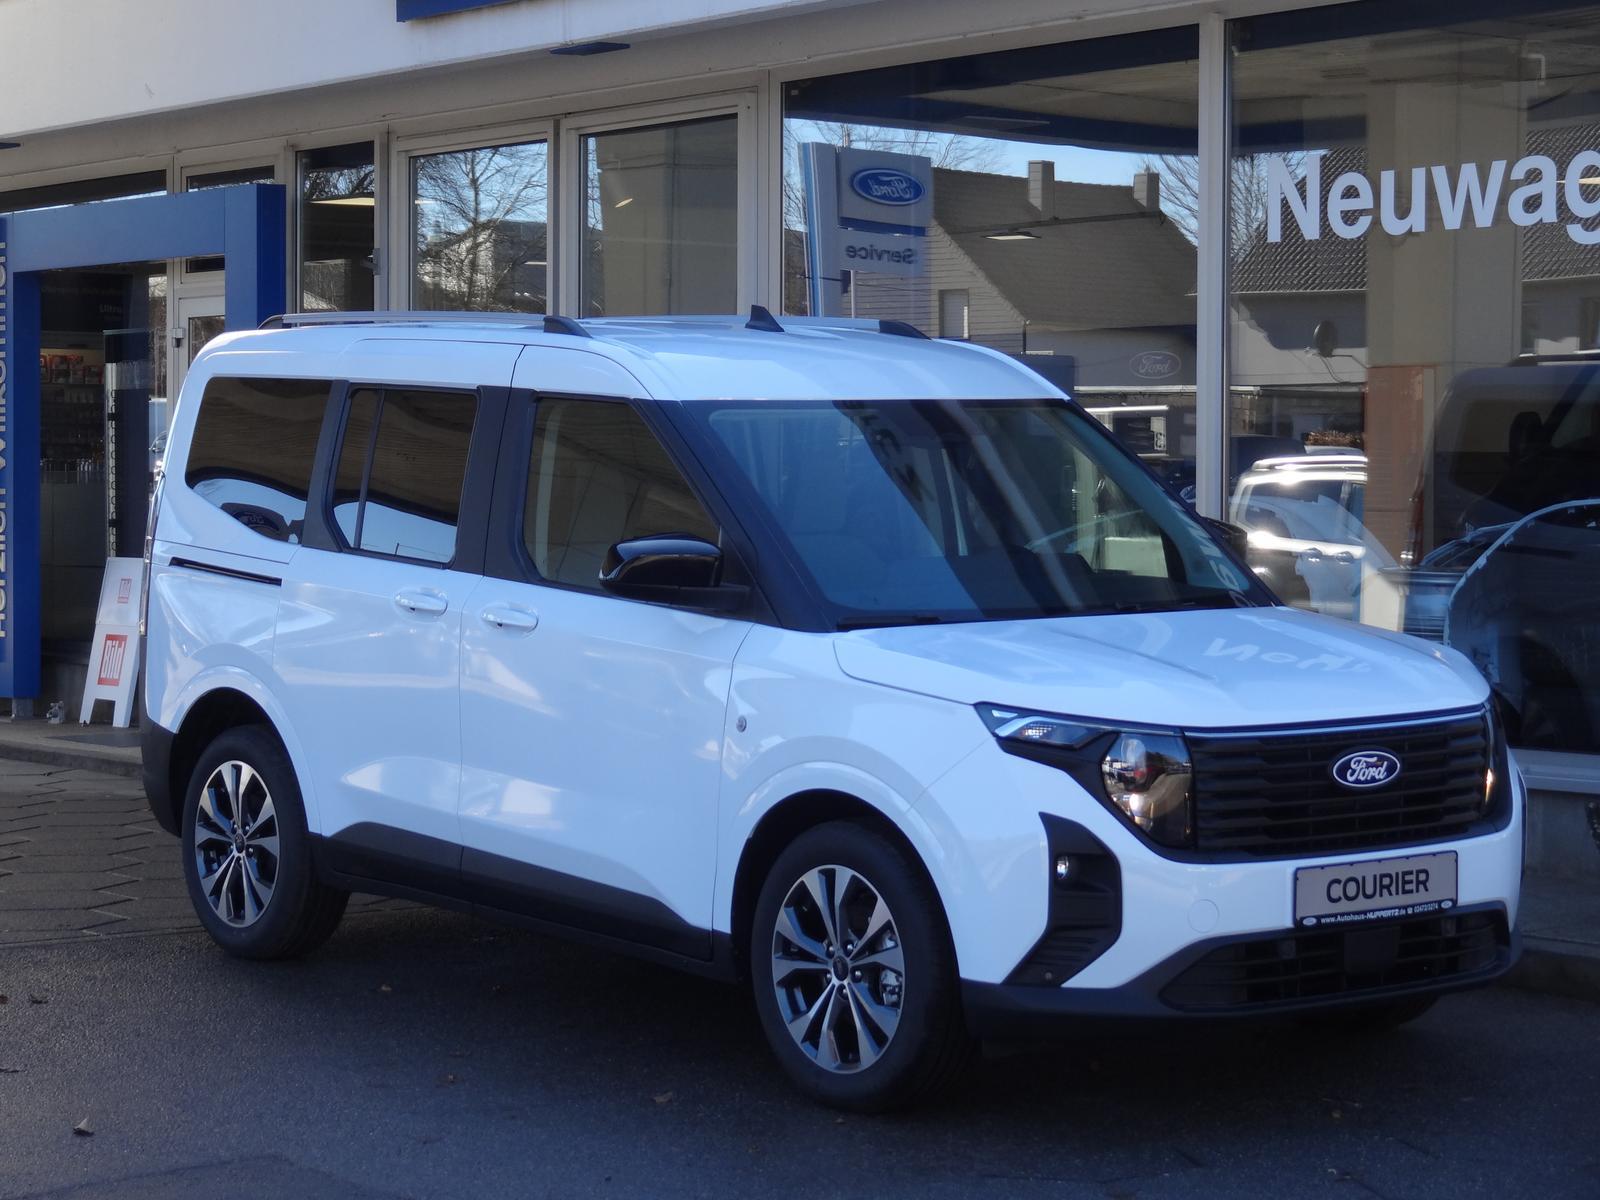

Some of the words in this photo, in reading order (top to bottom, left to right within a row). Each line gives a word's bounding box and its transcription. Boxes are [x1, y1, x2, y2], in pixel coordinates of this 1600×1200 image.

[101, 639, 125, 680] Bild
[1345, 754, 1389, 783] Ford
[1326, 868, 1430, 904] COURIER
